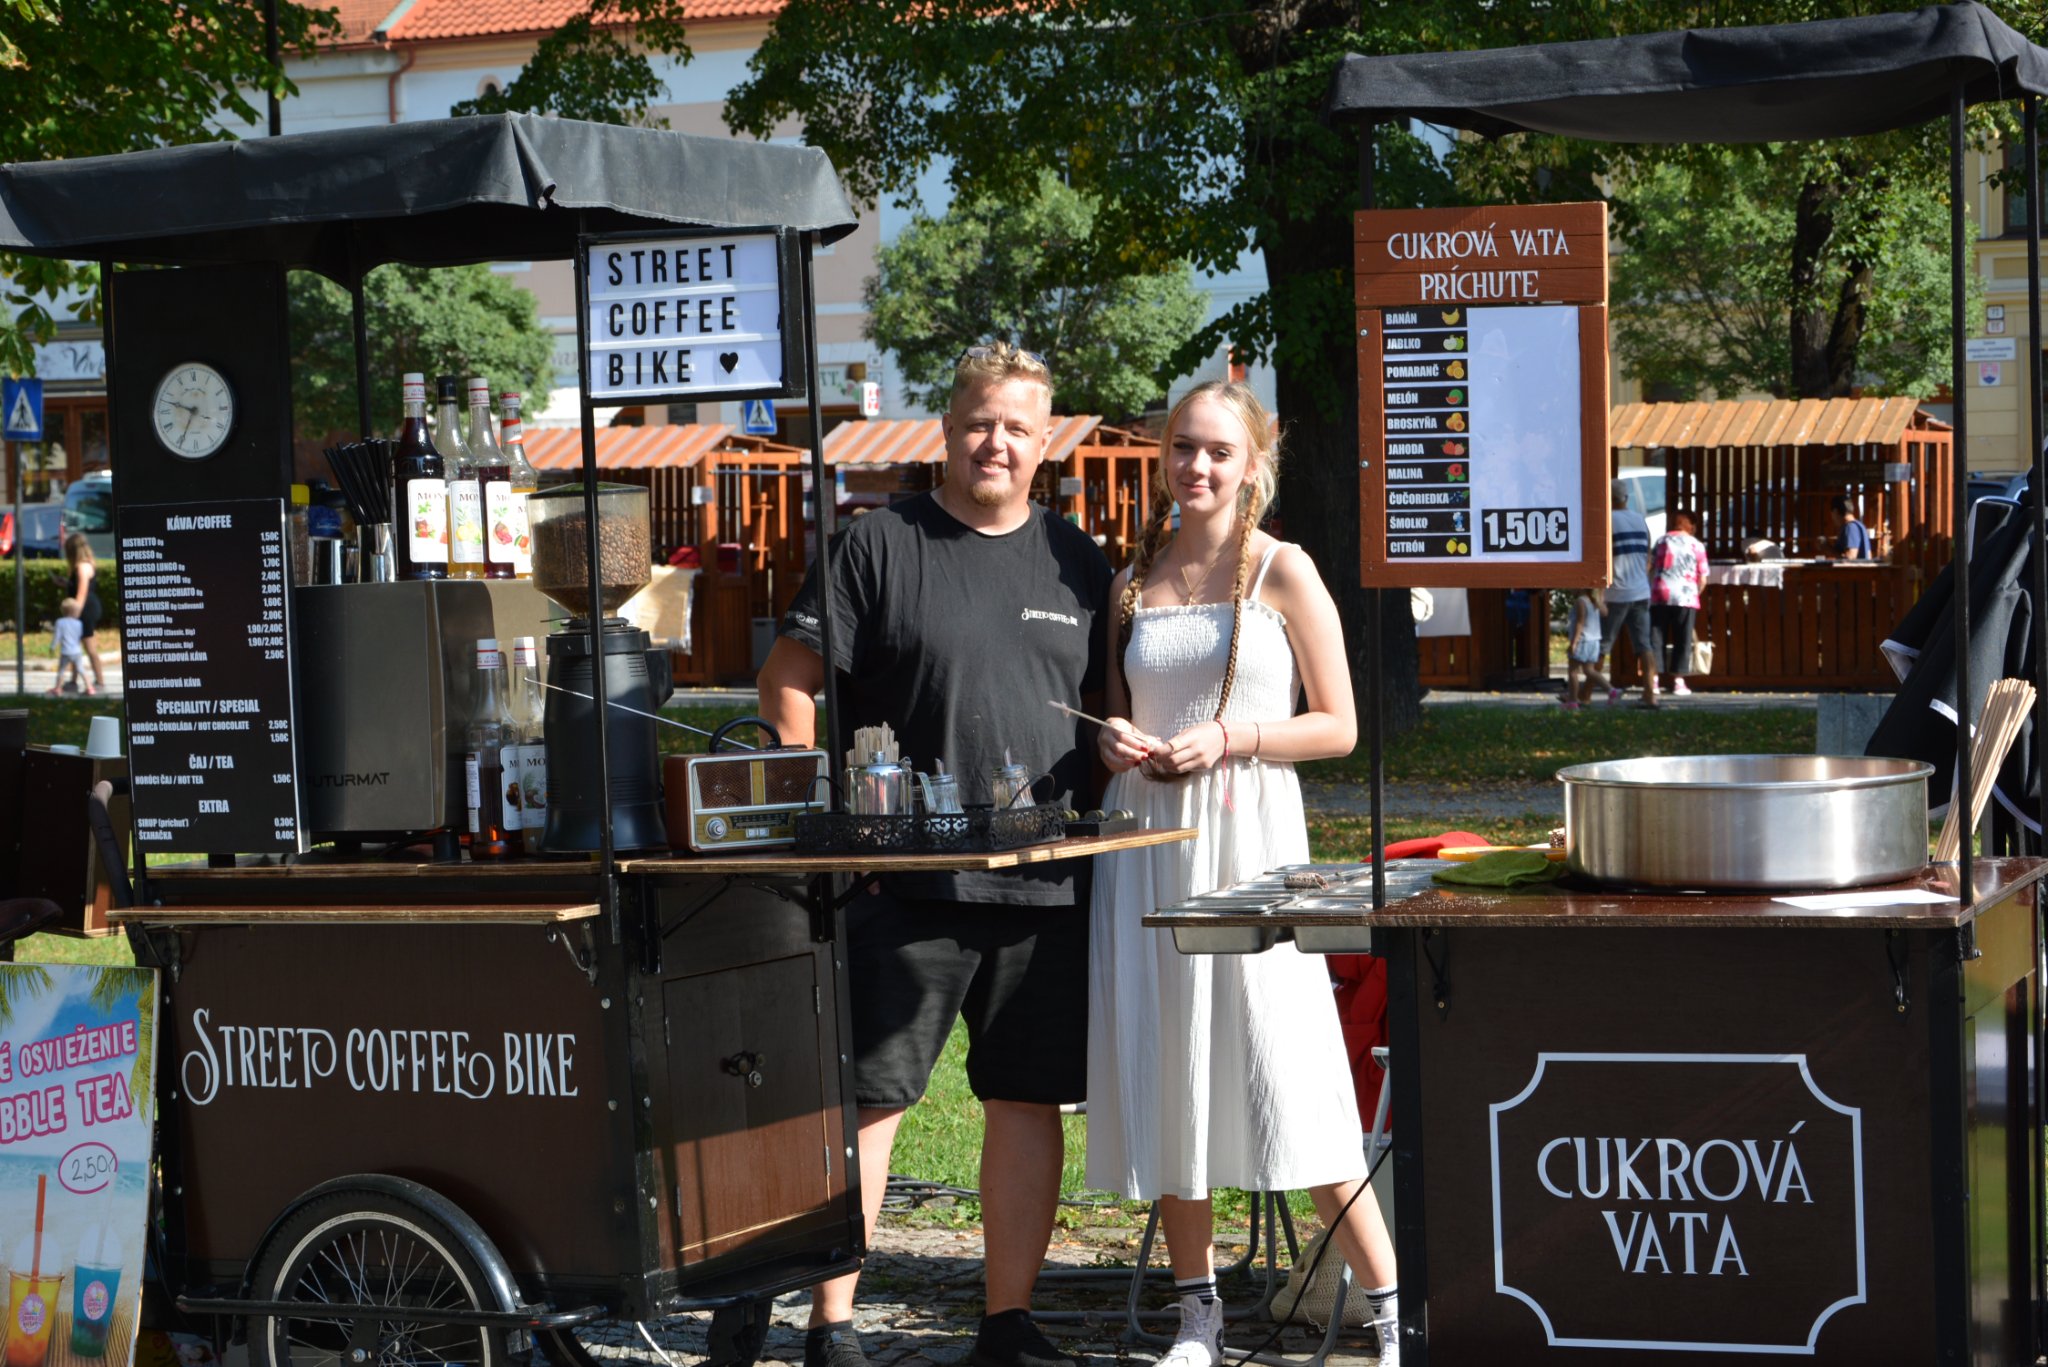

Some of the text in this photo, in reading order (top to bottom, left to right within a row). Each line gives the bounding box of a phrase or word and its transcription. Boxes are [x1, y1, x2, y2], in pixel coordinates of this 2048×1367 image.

[1387, 222, 1570, 260] CUKROVÁ VATA
[608, 244, 736, 286] STREET
[1420, 265, 1539, 300] PRÍCHUTE
[609, 297, 735, 337] COFFEE
[1385, 311, 1418, 325] BANÁN
[1386, 338, 1421, 350] JABLKO
[609, 349, 691, 386] BIKE
[1386, 364, 1440, 378] POMARANČ
[1387, 391, 1419, 404] MELÓN
[1387, 416, 1438, 430] BROSKYŇA
[1388, 443, 1425, 455] JAHODA
[1387, 468, 1423, 480] MALINA
[1389, 491, 1450, 505] ČUČORIEDKA
[166, 515, 232, 531] KÁVA/COFFEE
[1484, 510, 1567, 549] 1,50€
[1390, 540, 1425, 553] CITRÓN
[123, 550, 155, 560] ESPRESSO
[124, 563, 155, 573] ESPRESSO
[156, 562, 177, 571] LUNGO
[124, 576, 156, 586] ESPRESSO
[157, 575, 181, 584] DOPPIO
[124, 589, 157, 599] ESPRESSO
[125, 601, 141, 611] CAFÉ
[142, 601, 170, 610] TURKISH
[126, 614, 141, 624] CAFÉ
[127, 639, 143, 650] CAFÉ
[143, 640, 162, 649] LATTE
[127, 654, 139, 663] ICE
[190, 650, 208, 661] KÁVA
[184, 676, 202, 687] KÁVA
[156, 699, 211, 715] ŠPECIALITY
[219, 699, 260, 713] SPECIAL
[212, 721, 250, 730] CHOCOLATE
[132, 735, 155, 745] KAKAO
[189, 754, 207, 769] ČAJ
[215, 755, 234, 769] TEA
[160, 774, 173, 785] ČAJ
[192, 775, 204, 784] TEA
[198, 800, 230, 813] EXTRA
[19, 1021, 137, 1078] OSVIEŽENIE
[181, 1008, 578, 1105] STREET COFFEE BIKE
[76, 1071, 133, 1127] TEA
[1537, 1120, 1815, 1204] CUKROVÁ
[1601, 1210, 1749, 1276] VATA
